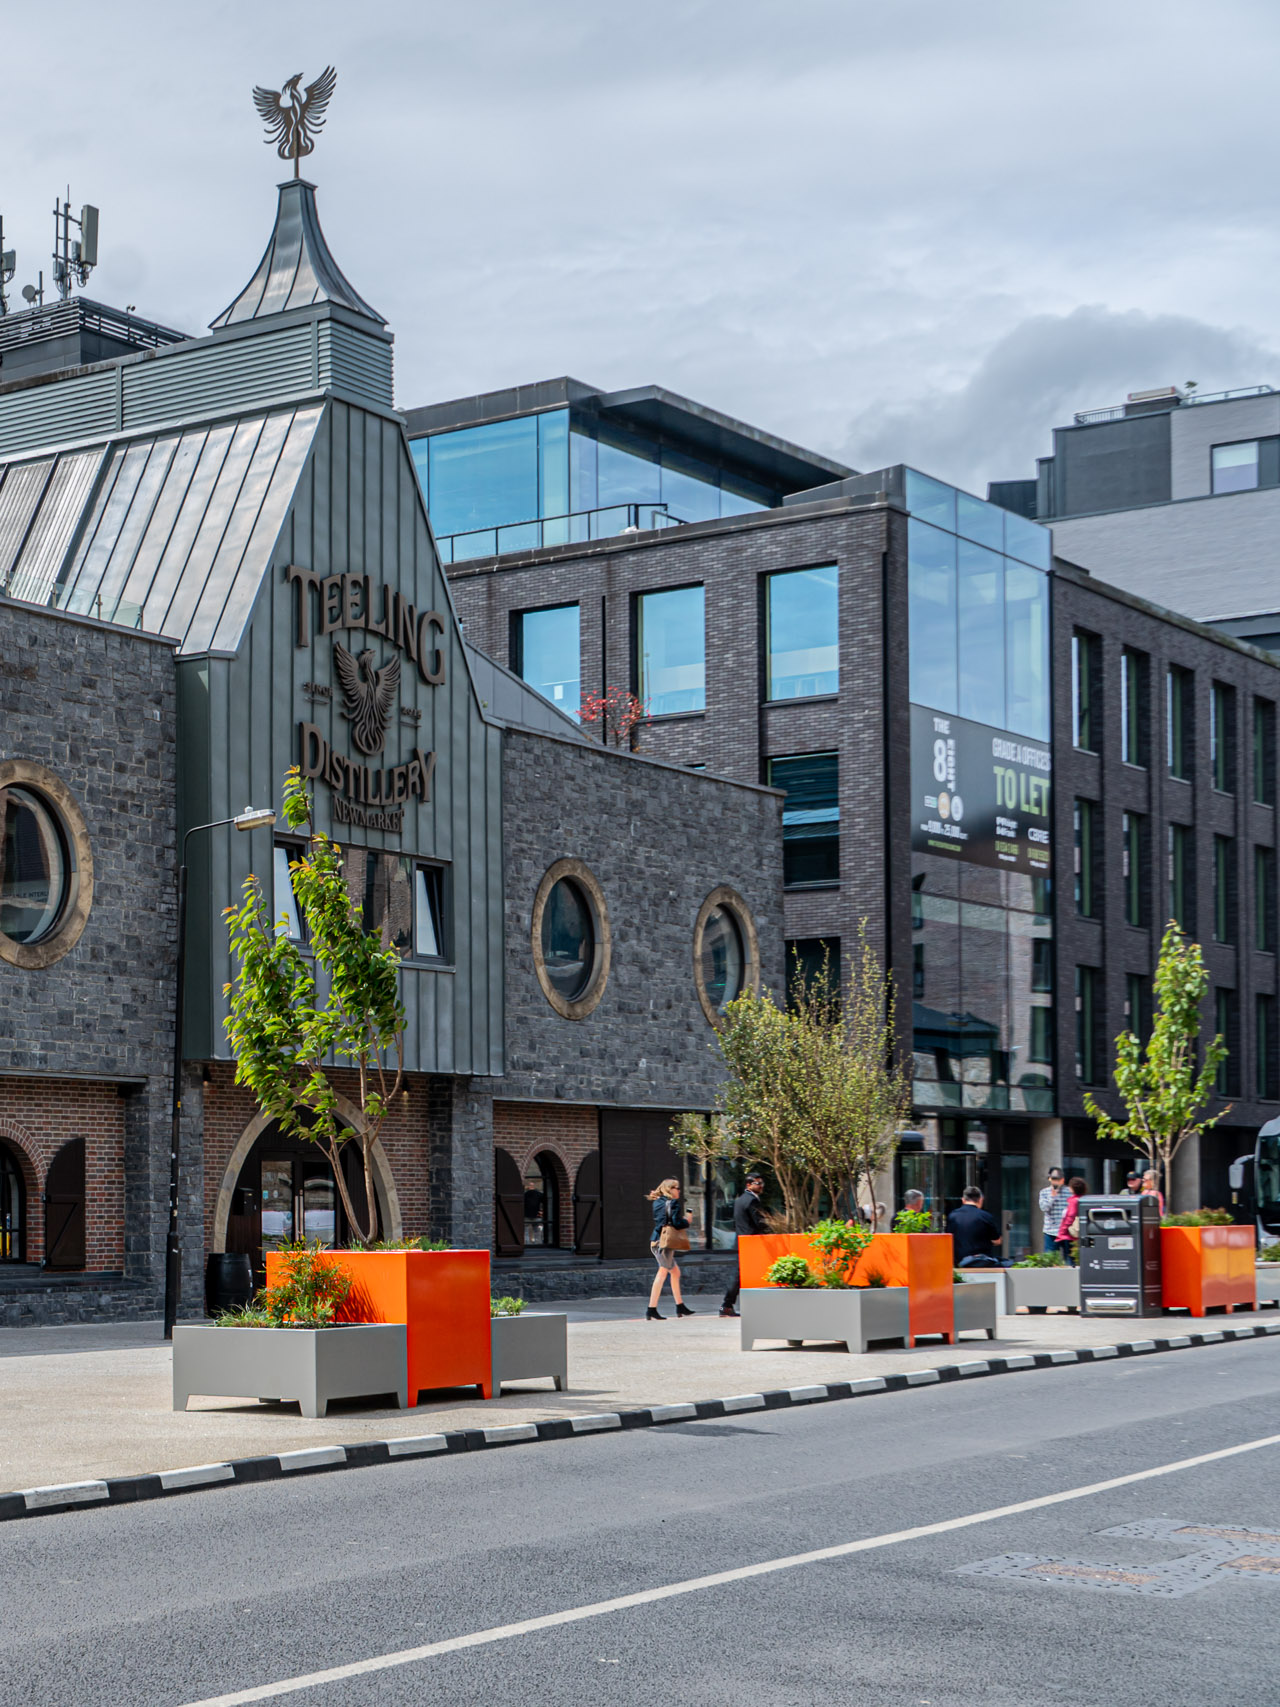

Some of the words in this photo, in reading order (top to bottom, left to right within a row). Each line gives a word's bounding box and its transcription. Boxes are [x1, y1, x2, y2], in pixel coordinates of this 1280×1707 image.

[286, 565, 446, 686] TEELING
[933, 717, 951, 735] THE
[299, 721, 438, 804] DISTILLERY
[933, 739, 947, 782] 8
[946, 739, 956, 792] EIGHT
[331, 794, 406, 833] NEWMARKET
[993, 765, 1017, 809] TO
[1020, 772, 1051, 817] LET
[1028, 827, 1050, 844] CBRE
